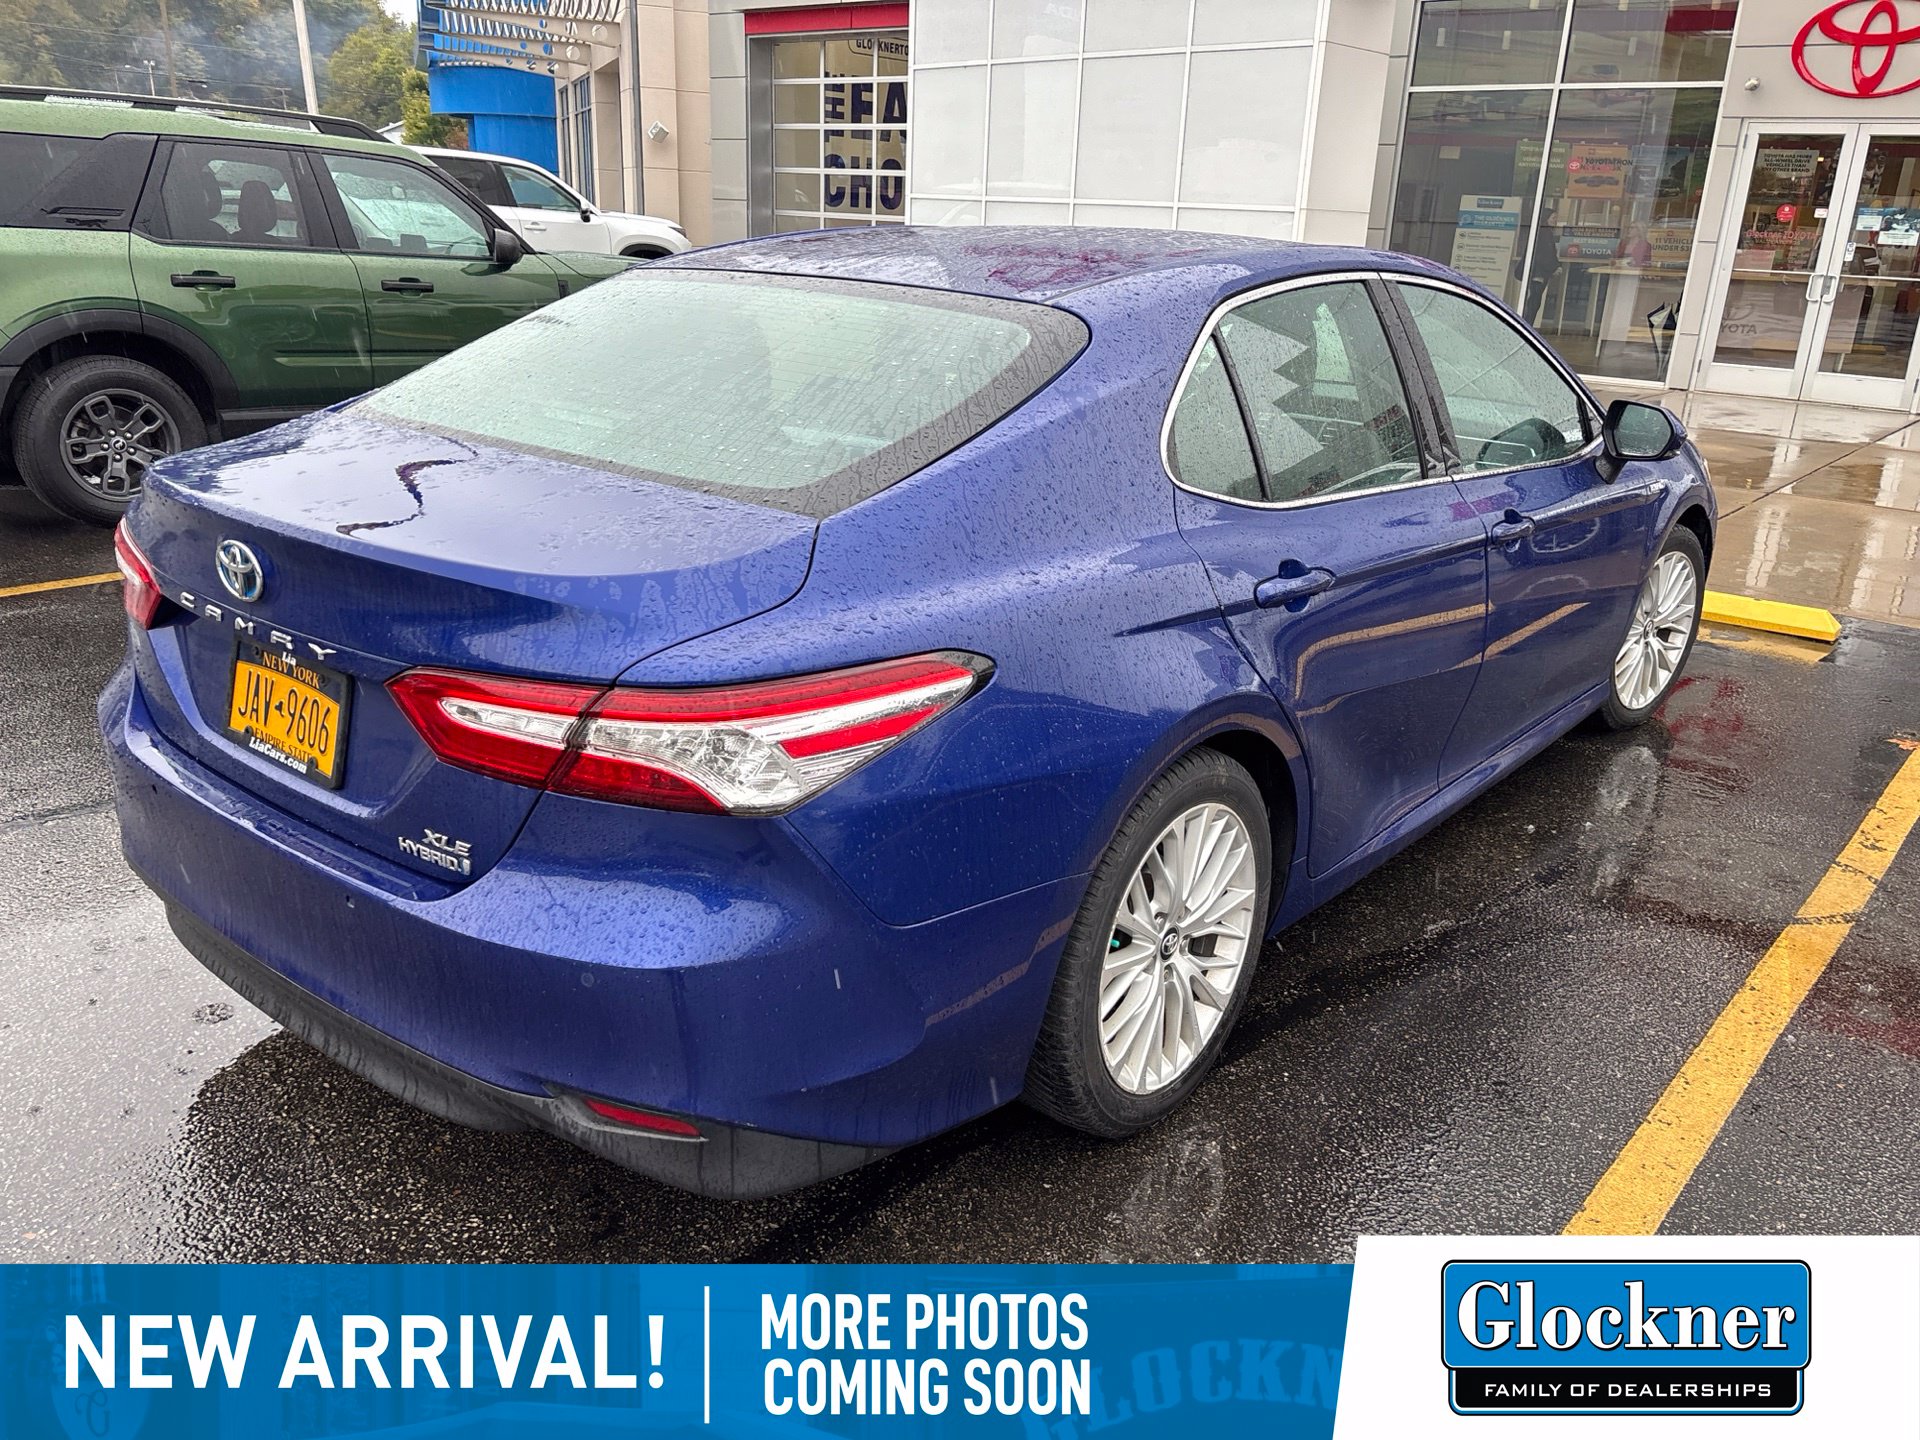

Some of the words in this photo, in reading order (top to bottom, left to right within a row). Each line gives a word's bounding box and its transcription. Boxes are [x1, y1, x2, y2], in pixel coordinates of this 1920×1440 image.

[856, 39, 909, 56] GLOKNERTO
[1582, 247, 1612, 255] TOYOTA
[180, 591, 338, 661] CAMRY
[262, 651, 290, 674] NEW
[293, 666, 320, 689] YORK
[281, 651, 297, 666] Lia
[237, 668, 276, 728] JAV
[286, 686, 331, 756] 9606
[248, 736, 308, 775] LiaCars.com
[397, 836, 459, 872] HYBRID
[421, 828, 473, 857] XLE
